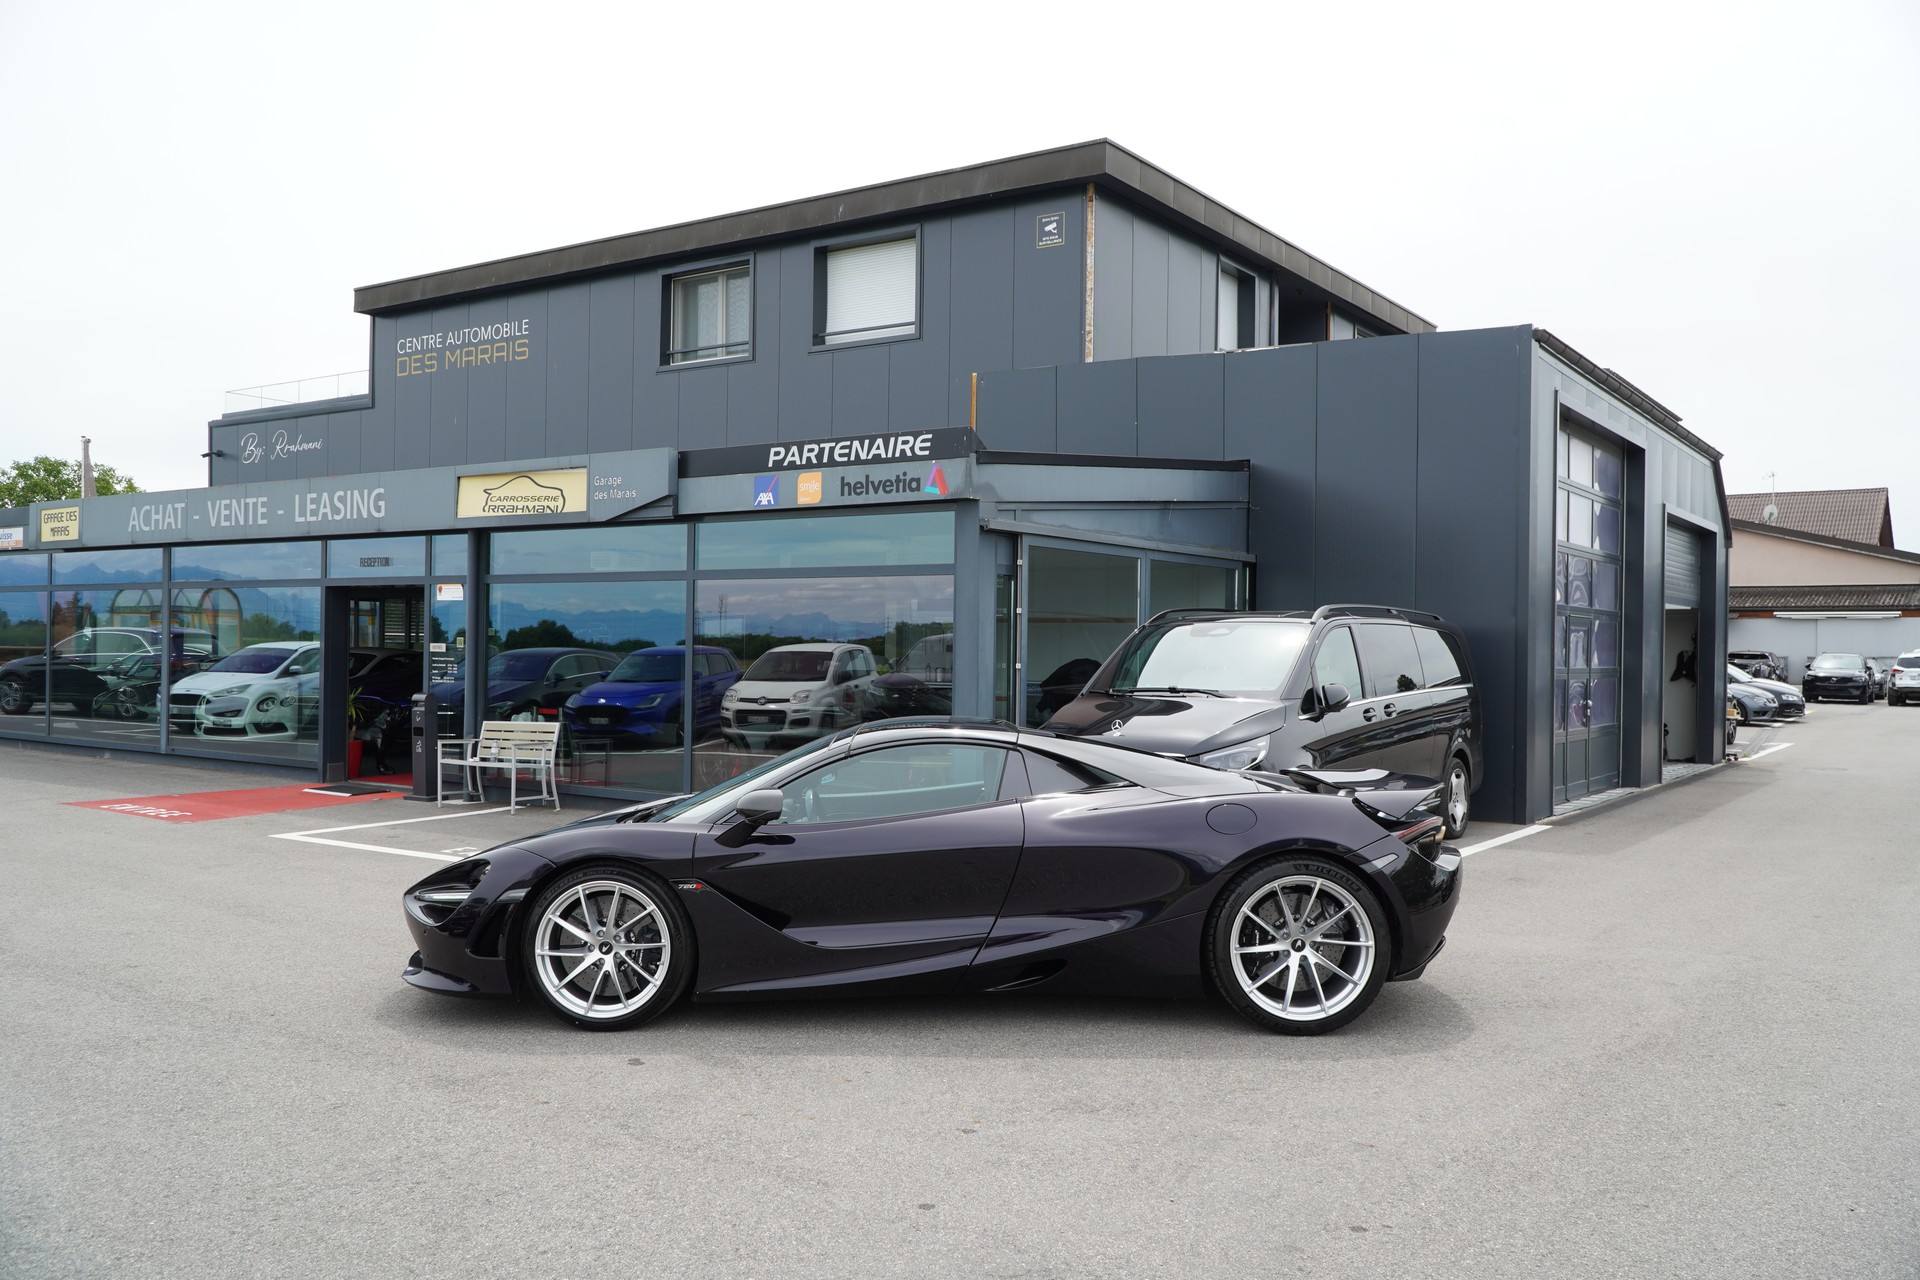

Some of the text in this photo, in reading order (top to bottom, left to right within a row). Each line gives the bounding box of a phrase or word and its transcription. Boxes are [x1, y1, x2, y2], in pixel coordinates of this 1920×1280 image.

[397, 319, 530, 354] CENTRE AUTOMOBILE
[396, 339, 529, 377] DES MARAIS
[241, 432, 266, 464] By:
[768, 433, 933, 468] PARTENAIRE
[594, 476, 622, 486] Garage
[799, 480, 820, 493] smile
[840, 471, 921, 497] helvetia
[489, 495, 560, 503] CARROSSERIE
[594, 488, 636, 500] des Marais
[754, 492, 775, 506] AXA
[65, 511, 78, 522] DES
[128, 503, 185, 532] ACHAT
[207, 497, 268, 527] VENTE
[294, 488, 386, 523] LEASING
